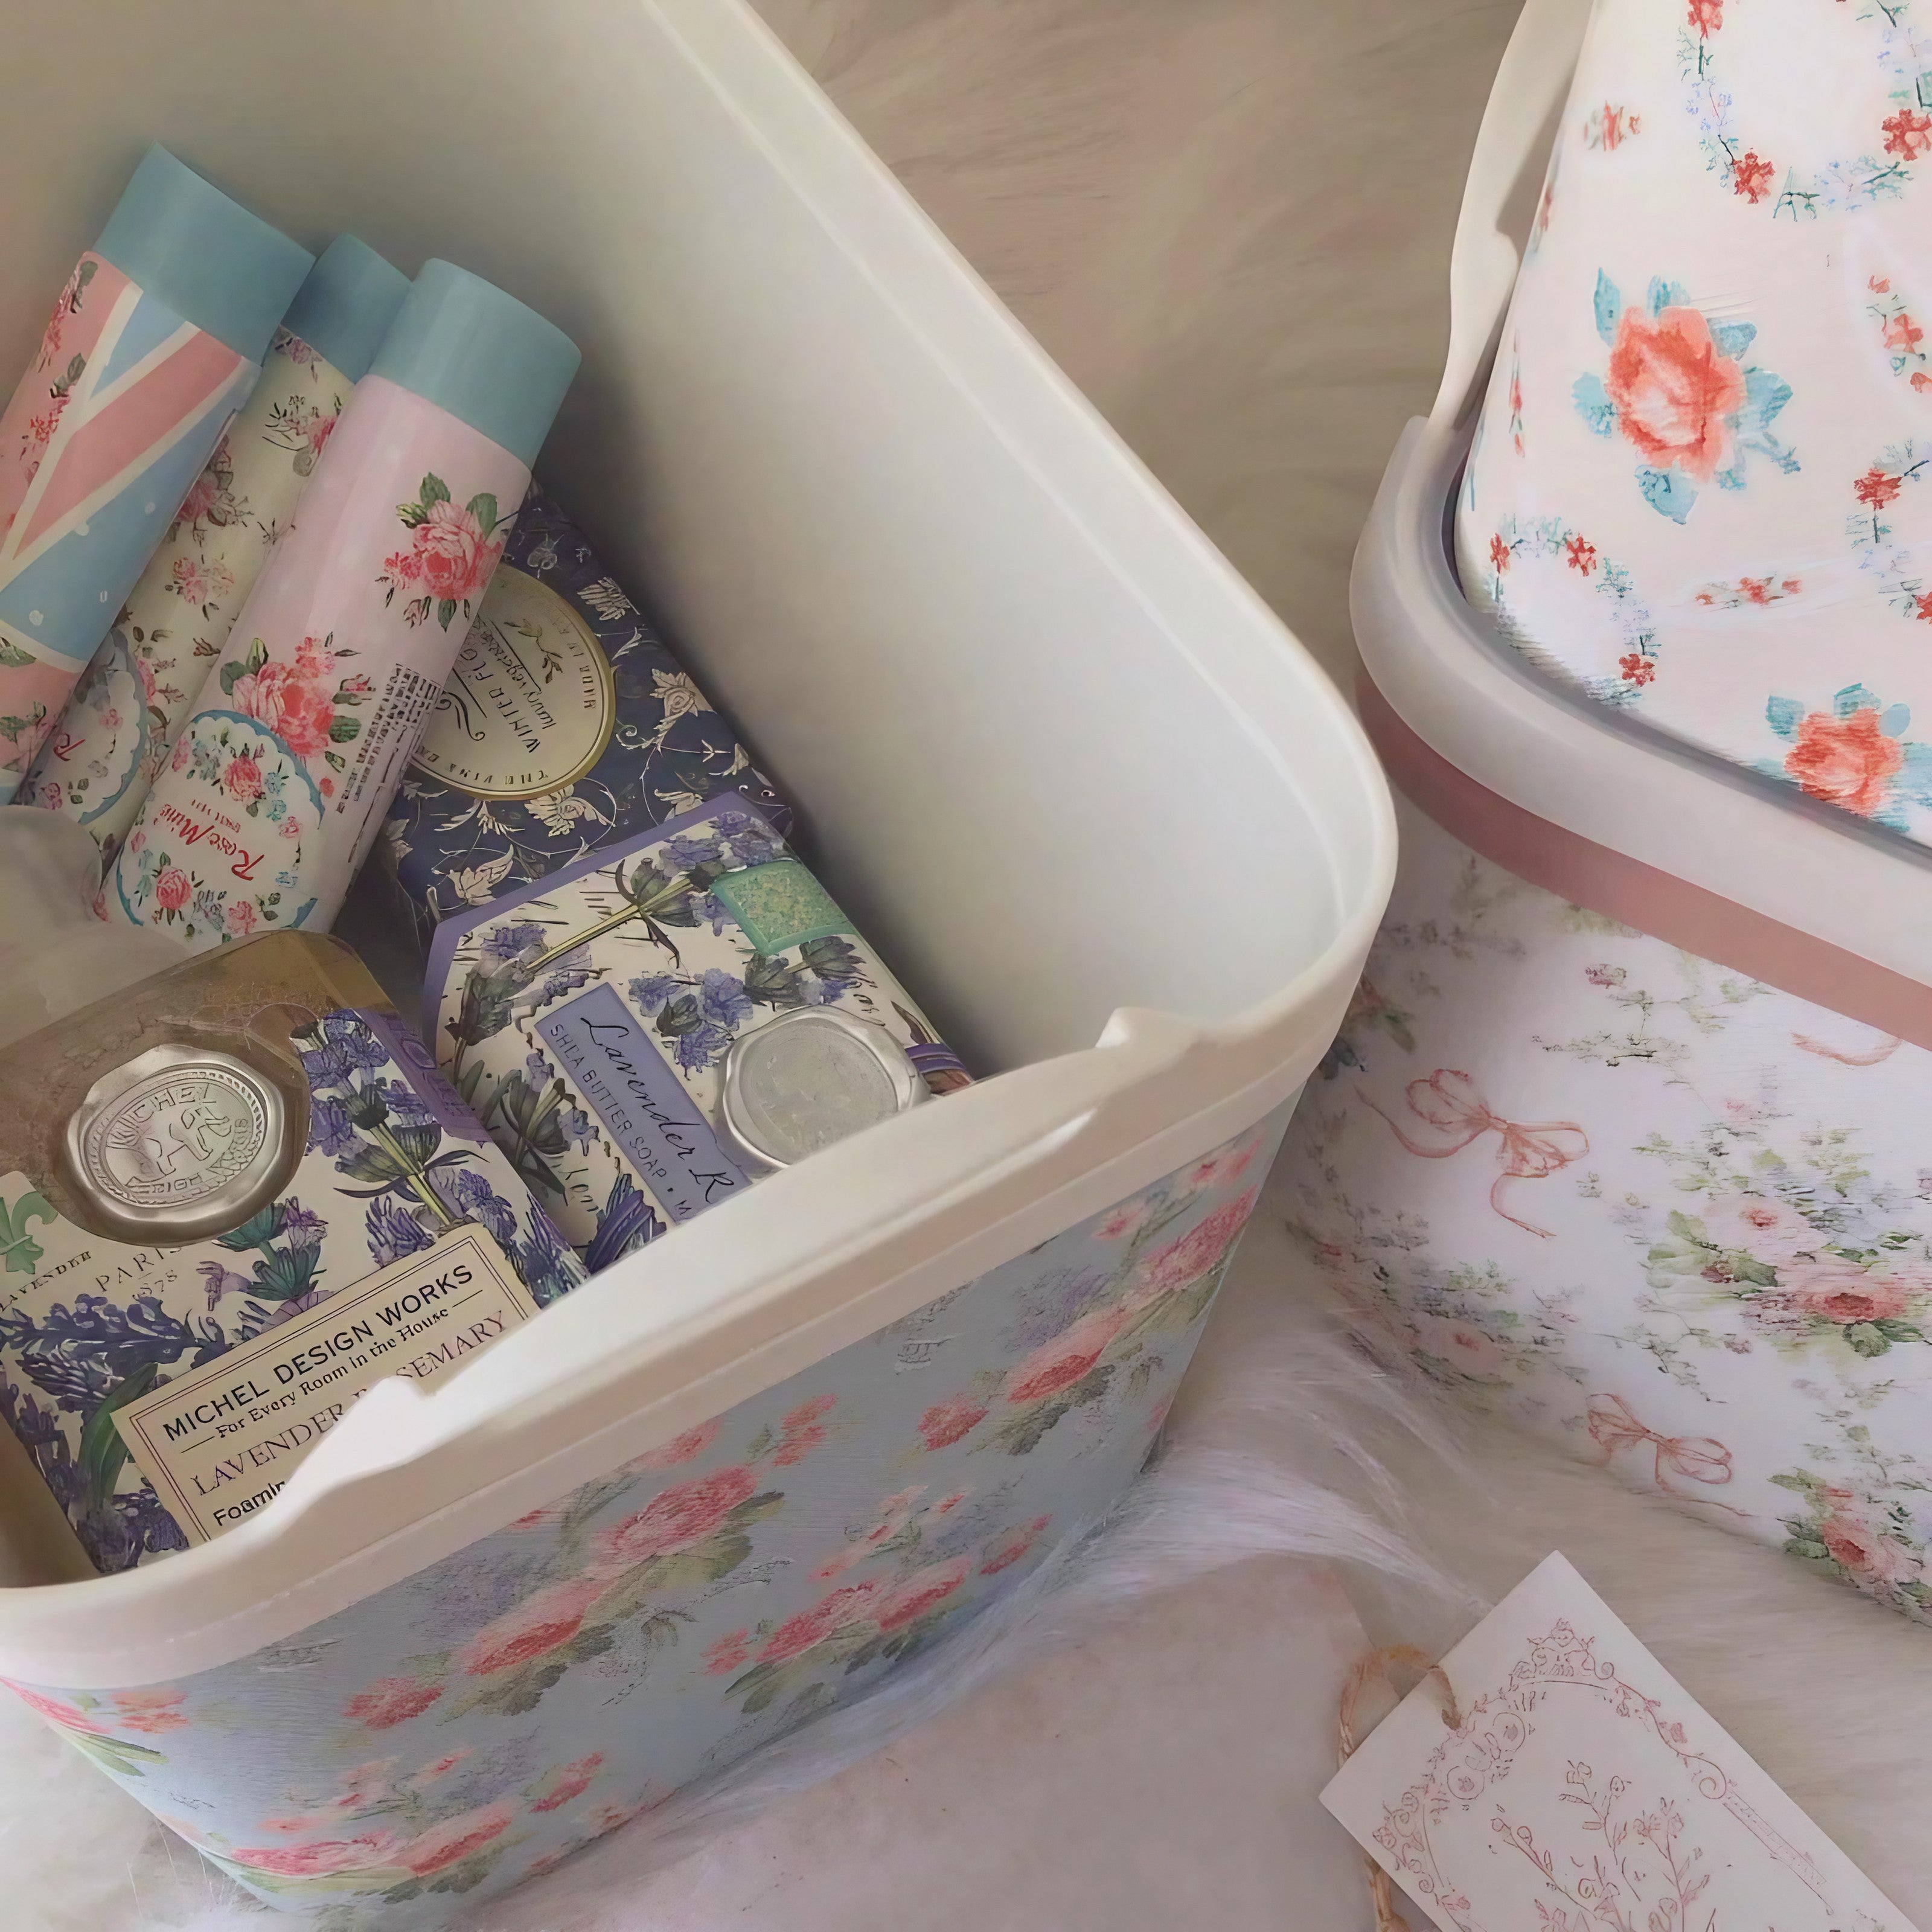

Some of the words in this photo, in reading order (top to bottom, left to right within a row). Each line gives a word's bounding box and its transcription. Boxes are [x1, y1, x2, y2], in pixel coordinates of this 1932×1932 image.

[551, 1024, 585, 1069] SHEA
[583, 1069, 633, 1136] BUTTER
[629, 1136, 667, 1178] SOAP
[580, 1017, 701, 1160] Lavender
[95, 1247, 181, 1292] PARI
[162, 1380, 270, 1441] MICHEL
[273, 1320, 375, 1383] DESIGN
[376, 1264, 473, 1322] WORKS
[216, 1417, 245, 1438] For
[248, 1390, 296, 1422] Every
[299, 1366, 348, 1396] Room
[395, 1308, 449, 1342] House
[190, 1403, 345, 1496] LAVENDER
